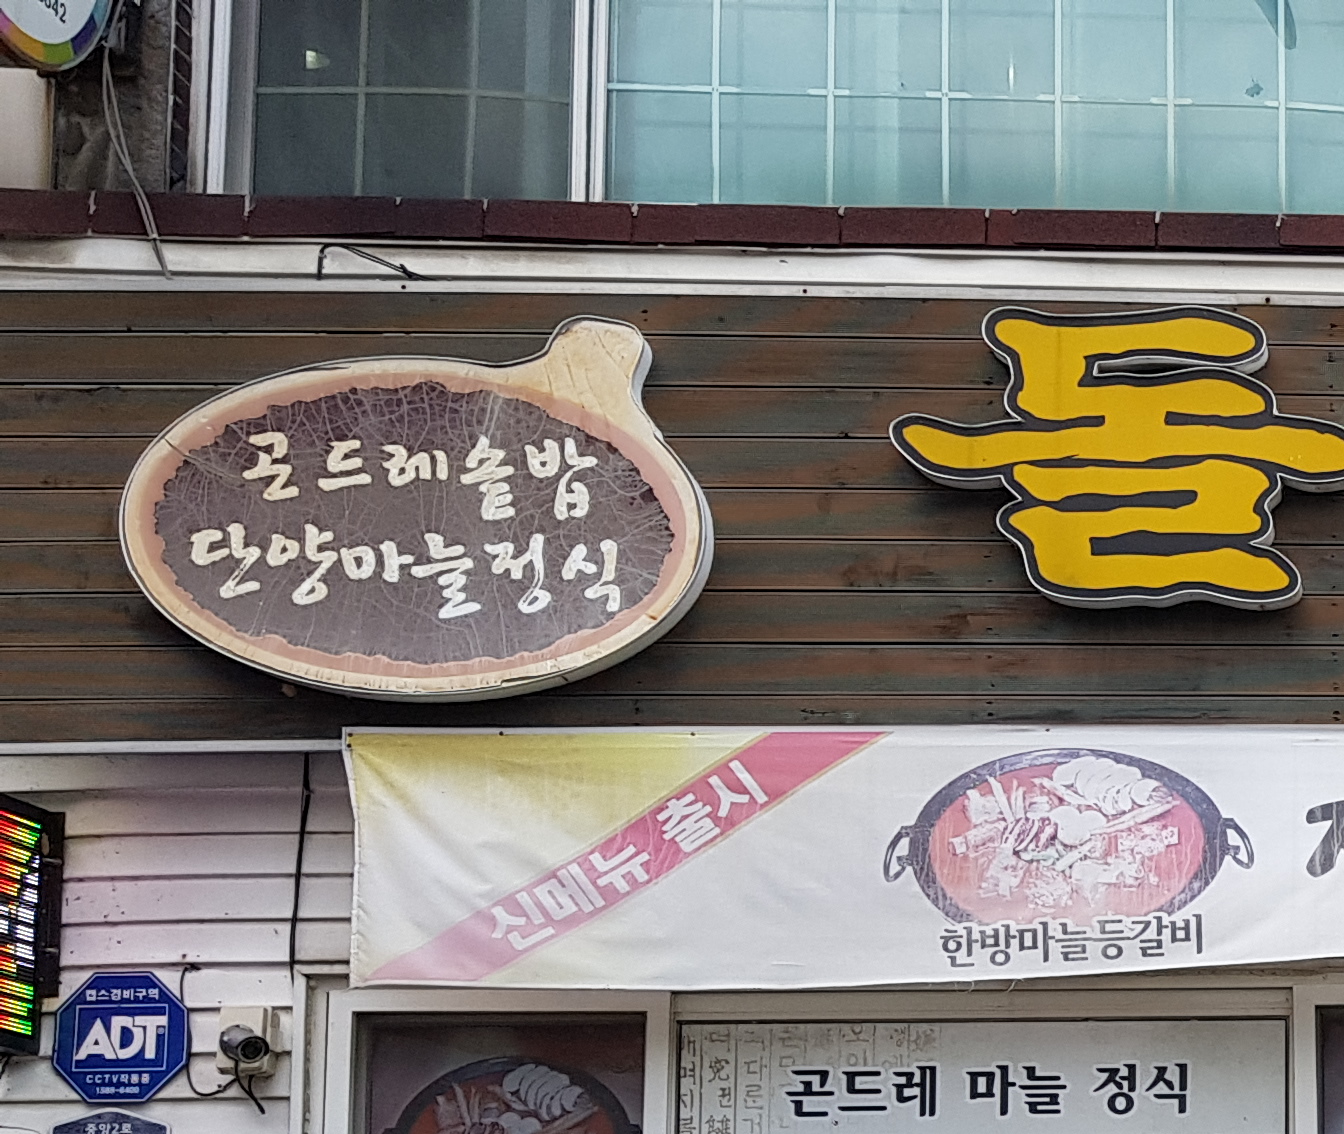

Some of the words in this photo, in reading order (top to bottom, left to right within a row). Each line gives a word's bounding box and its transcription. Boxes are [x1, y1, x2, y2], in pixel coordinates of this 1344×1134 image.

[489, 842, 653, 950] 신메뉴
[657, 759, 765, 853] 출시
[938, 913, 1204, 968] 한방마늘등갈비
[75, 1015, 168, 1060] ADT
[784, 1065, 938, 1118] 곤드레
[964, 1063, 1068, 1117] 마늘
[1092, 1062, 1189, 1116] 정식
